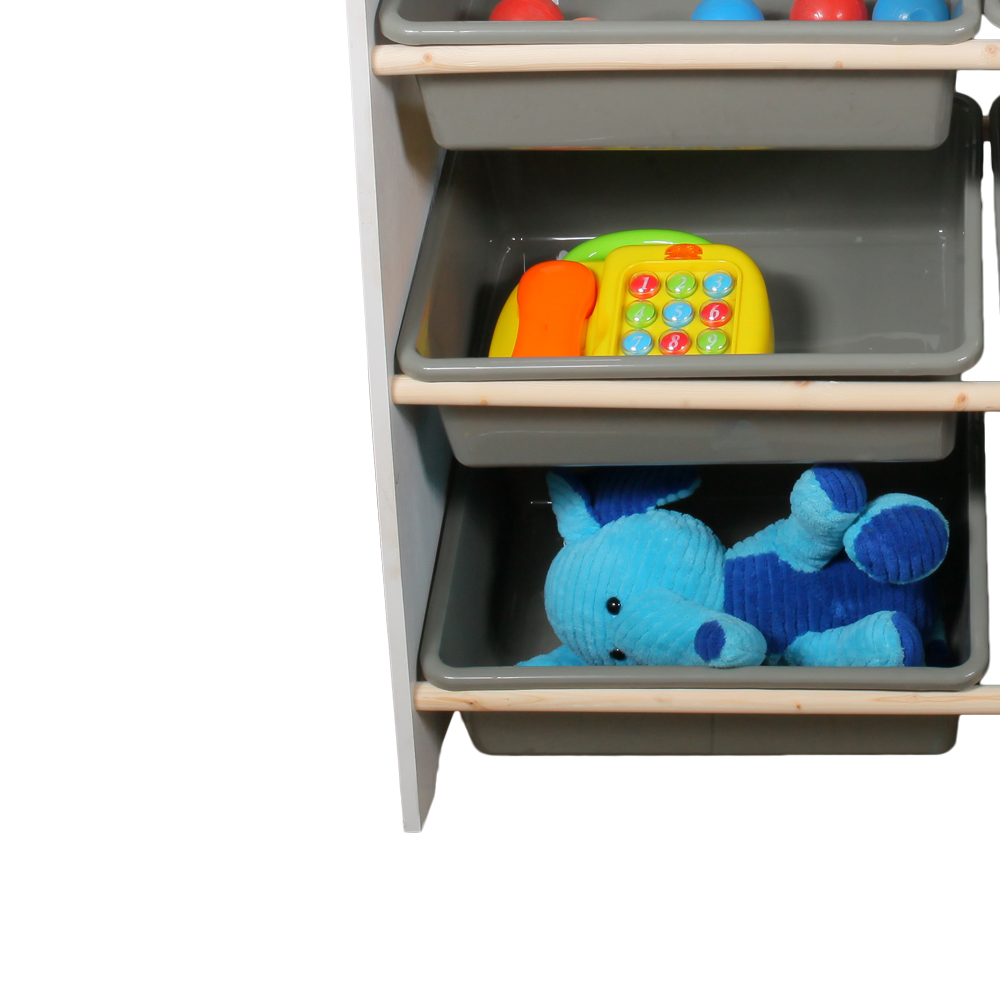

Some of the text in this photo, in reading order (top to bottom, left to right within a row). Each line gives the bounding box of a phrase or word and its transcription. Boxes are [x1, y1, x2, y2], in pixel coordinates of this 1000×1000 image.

[642, 275, 724, 290] 1 2 3
[634, 304, 720, 320] 4 5 6
[633, 333, 718, 349] 7 8 9
